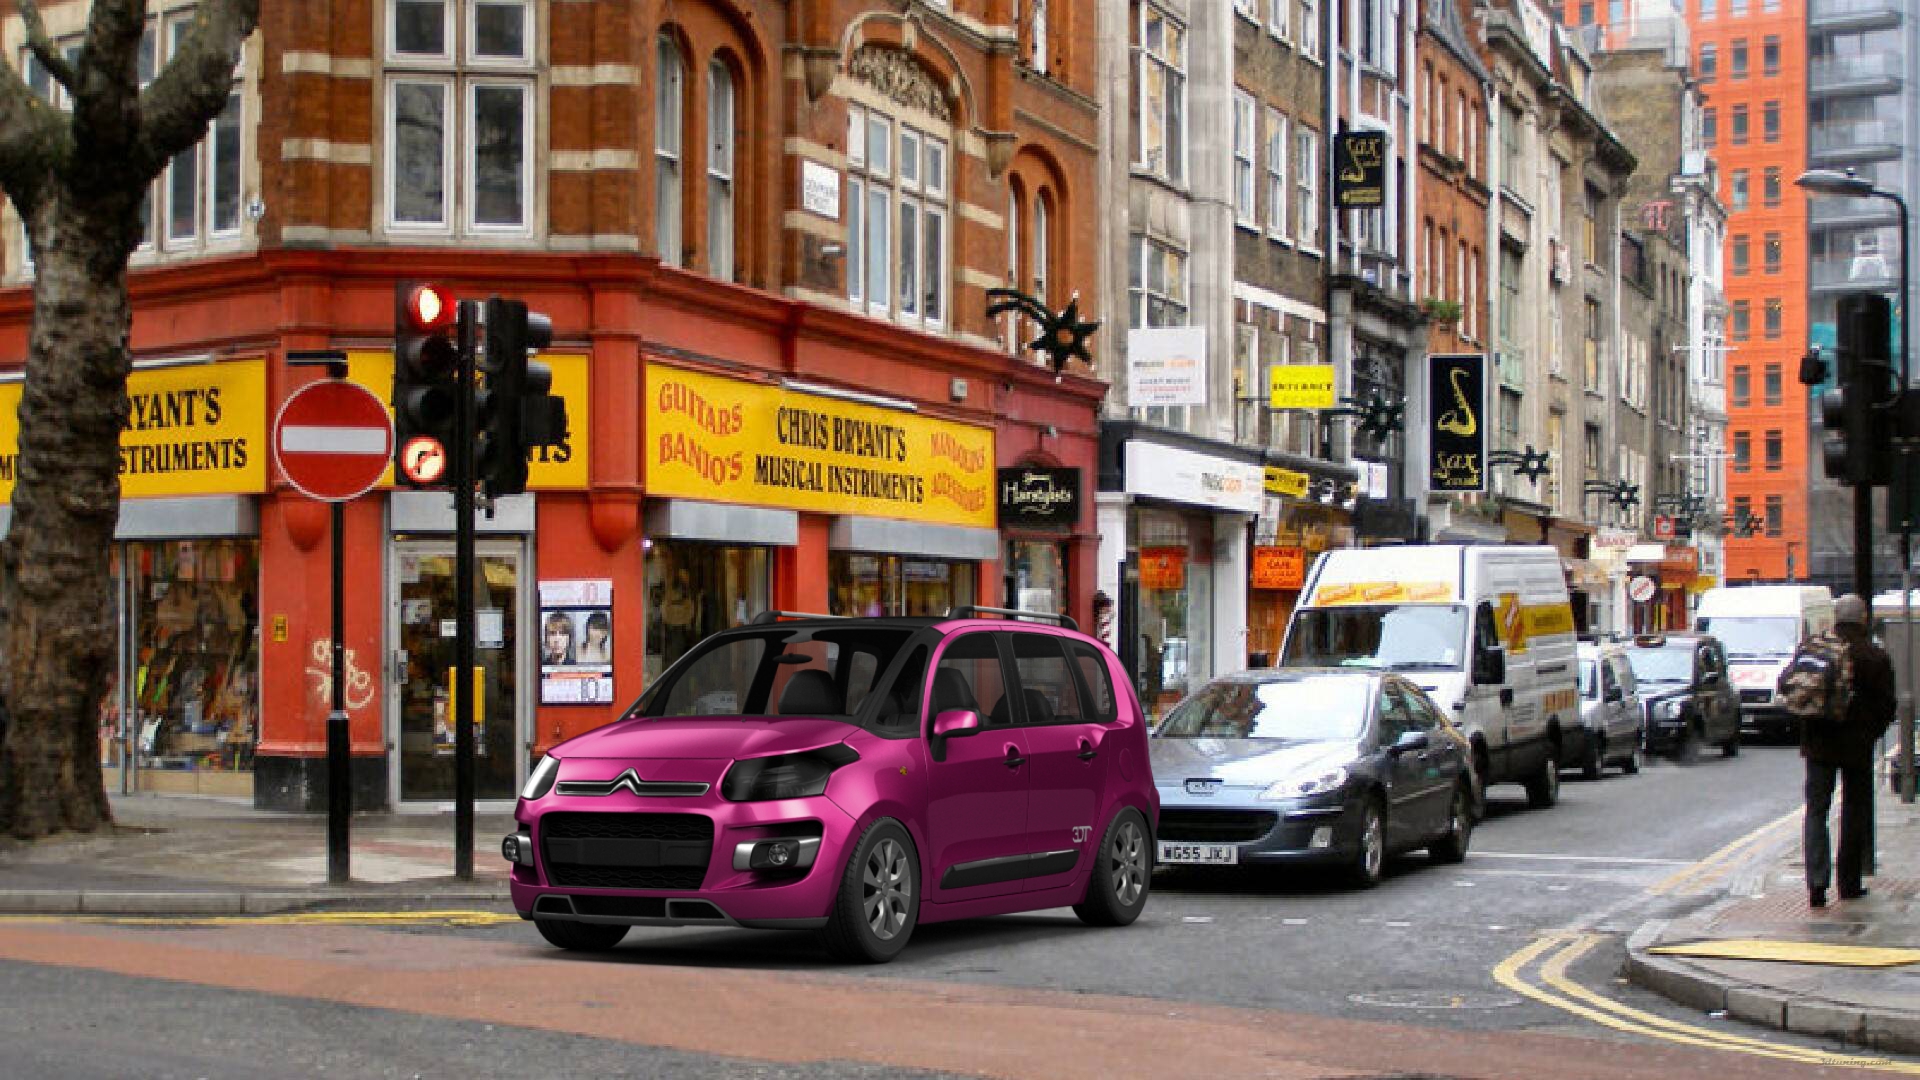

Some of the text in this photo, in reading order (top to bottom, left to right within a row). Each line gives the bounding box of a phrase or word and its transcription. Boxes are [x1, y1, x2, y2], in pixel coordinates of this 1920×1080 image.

[659, 382, 742, 435] GUITARS
[778, 405, 906, 462] CHRIS BRYANT'S
[659, 432, 743, 485] BANJO'S
[754, 453, 924, 504] MUSICAL INSTRUMENTS
